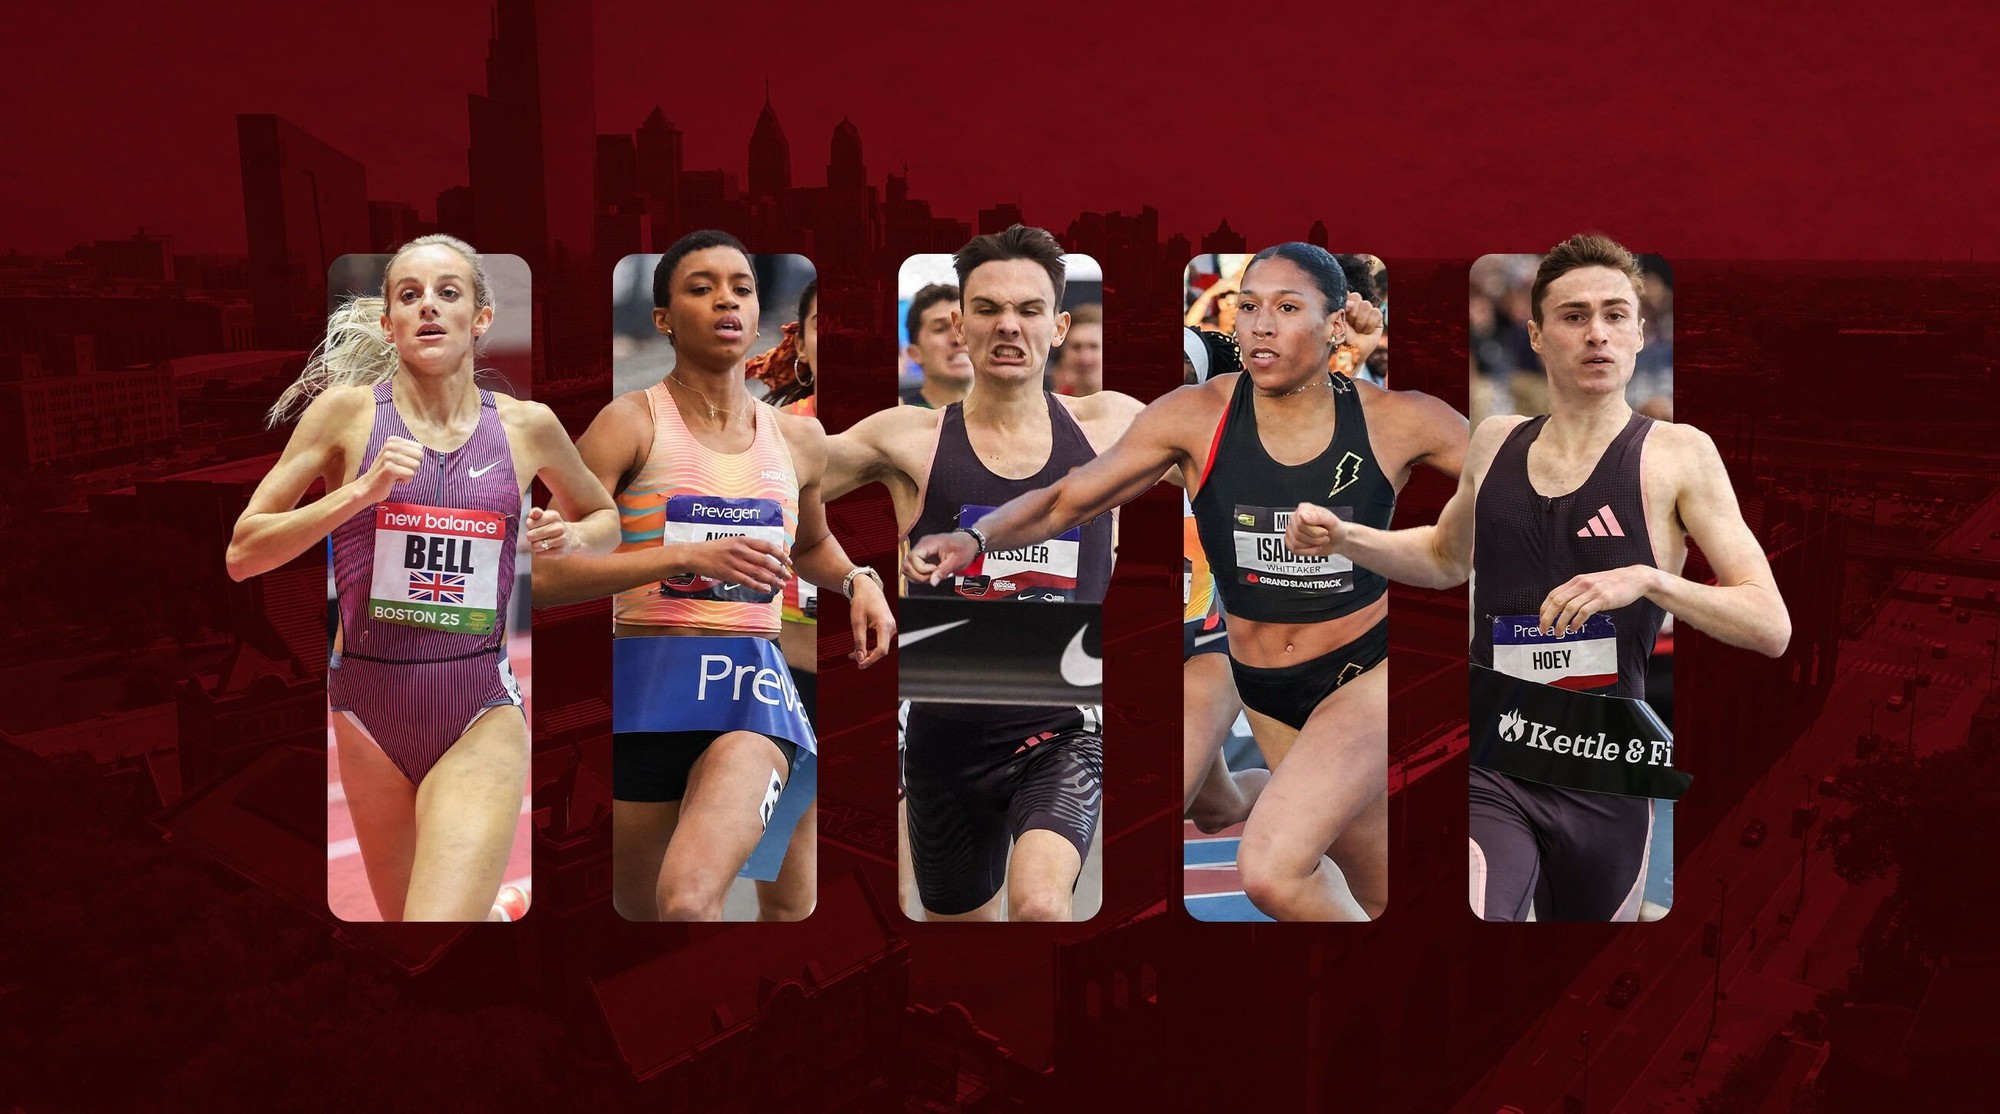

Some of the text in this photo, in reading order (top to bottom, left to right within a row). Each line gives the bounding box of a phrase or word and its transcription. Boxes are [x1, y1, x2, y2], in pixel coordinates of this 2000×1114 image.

[384, 511, 498, 535] new balance
[691, 502, 760, 523] Prevagen
[404, 534, 475, 575] BELL
[1256, 537, 1329, 563] ISAB
[1266, 564, 1322, 574] WHITTAKER
[1259, 576, 1342, 590] GRAND SLAM TRACK
[374, 606, 437, 624] BOSTON
[439, 612, 460, 626] 25
[1532, 649, 1572, 670] HOEY
[1526, 722, 1620, 761] Kettle
[1625, 738, 1645, 763] &
